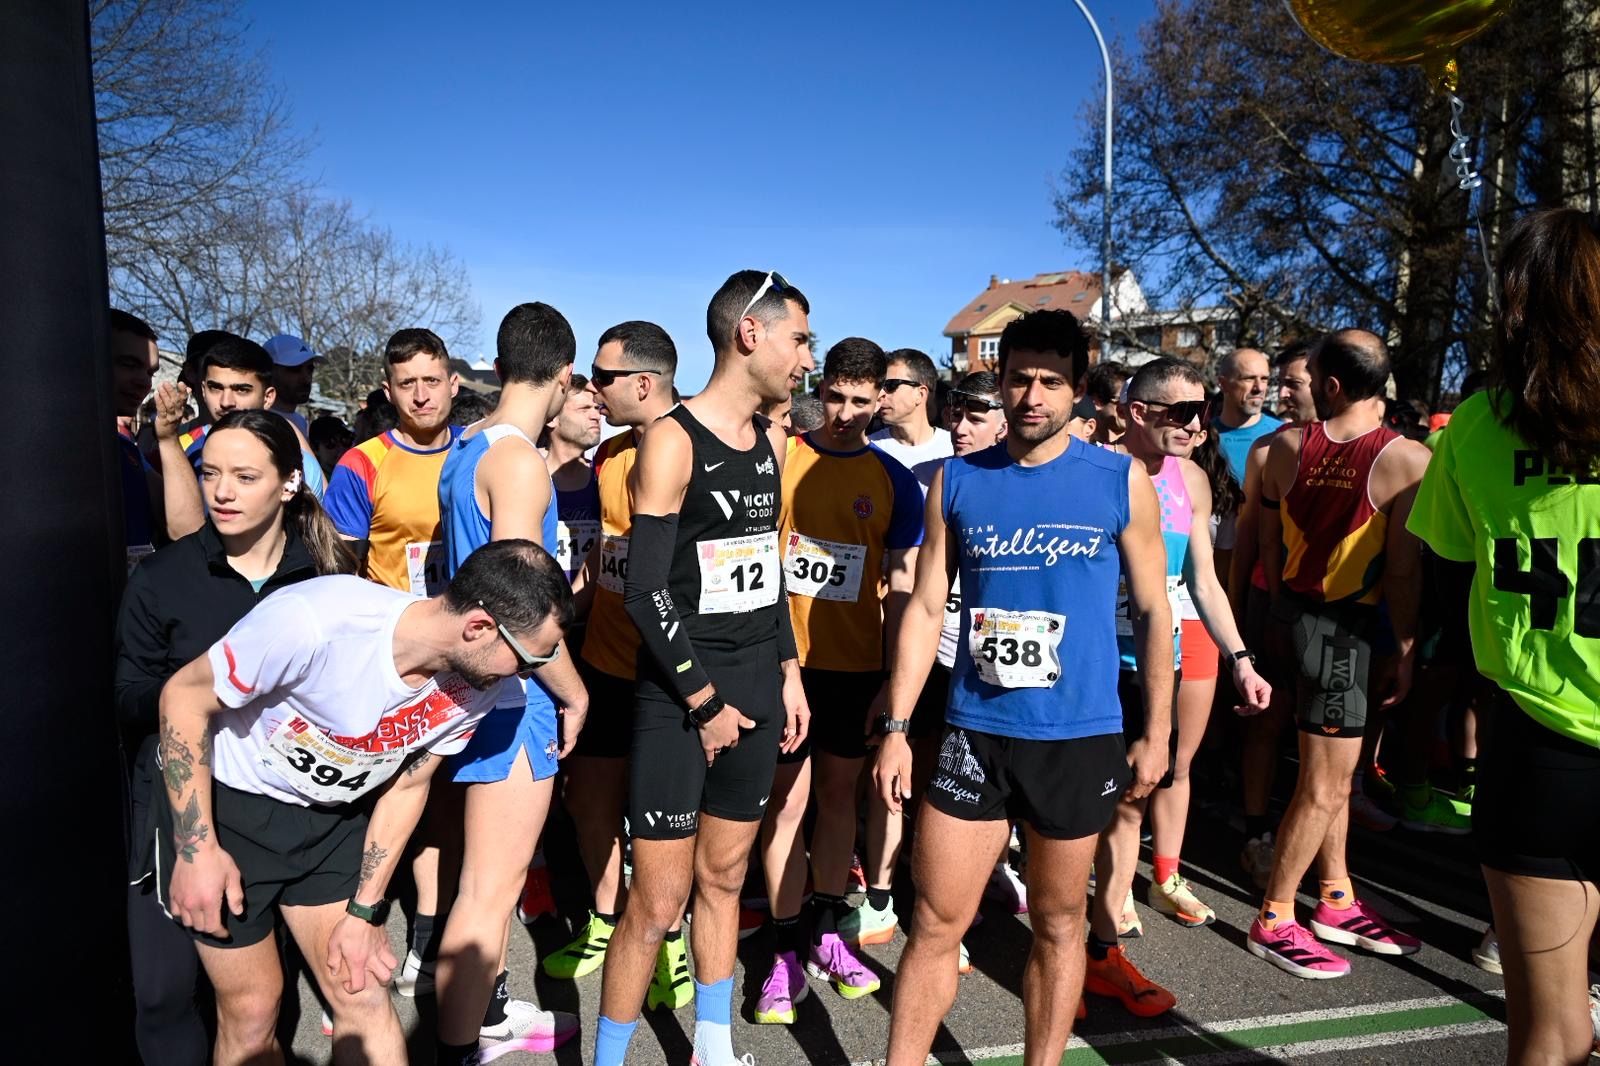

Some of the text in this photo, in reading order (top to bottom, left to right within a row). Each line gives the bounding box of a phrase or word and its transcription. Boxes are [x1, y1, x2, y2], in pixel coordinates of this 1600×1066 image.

[743, 492, 774, 507] VICKY
[746, 507, 773, 518] OODS
[962, 525, 994, 535] TEAM
[789, 534, 799, 547] 10
[730, 562, 764, 593] 12
[793, 557, 847, 586] 305
[981, 637, 1042, 668] 538
[1324, 659, 1350, 719] WONG
[287, 716, 309, 735] 10
[286, 747, 371, 792] 394
[666, 810, 697, 822] VICKY
